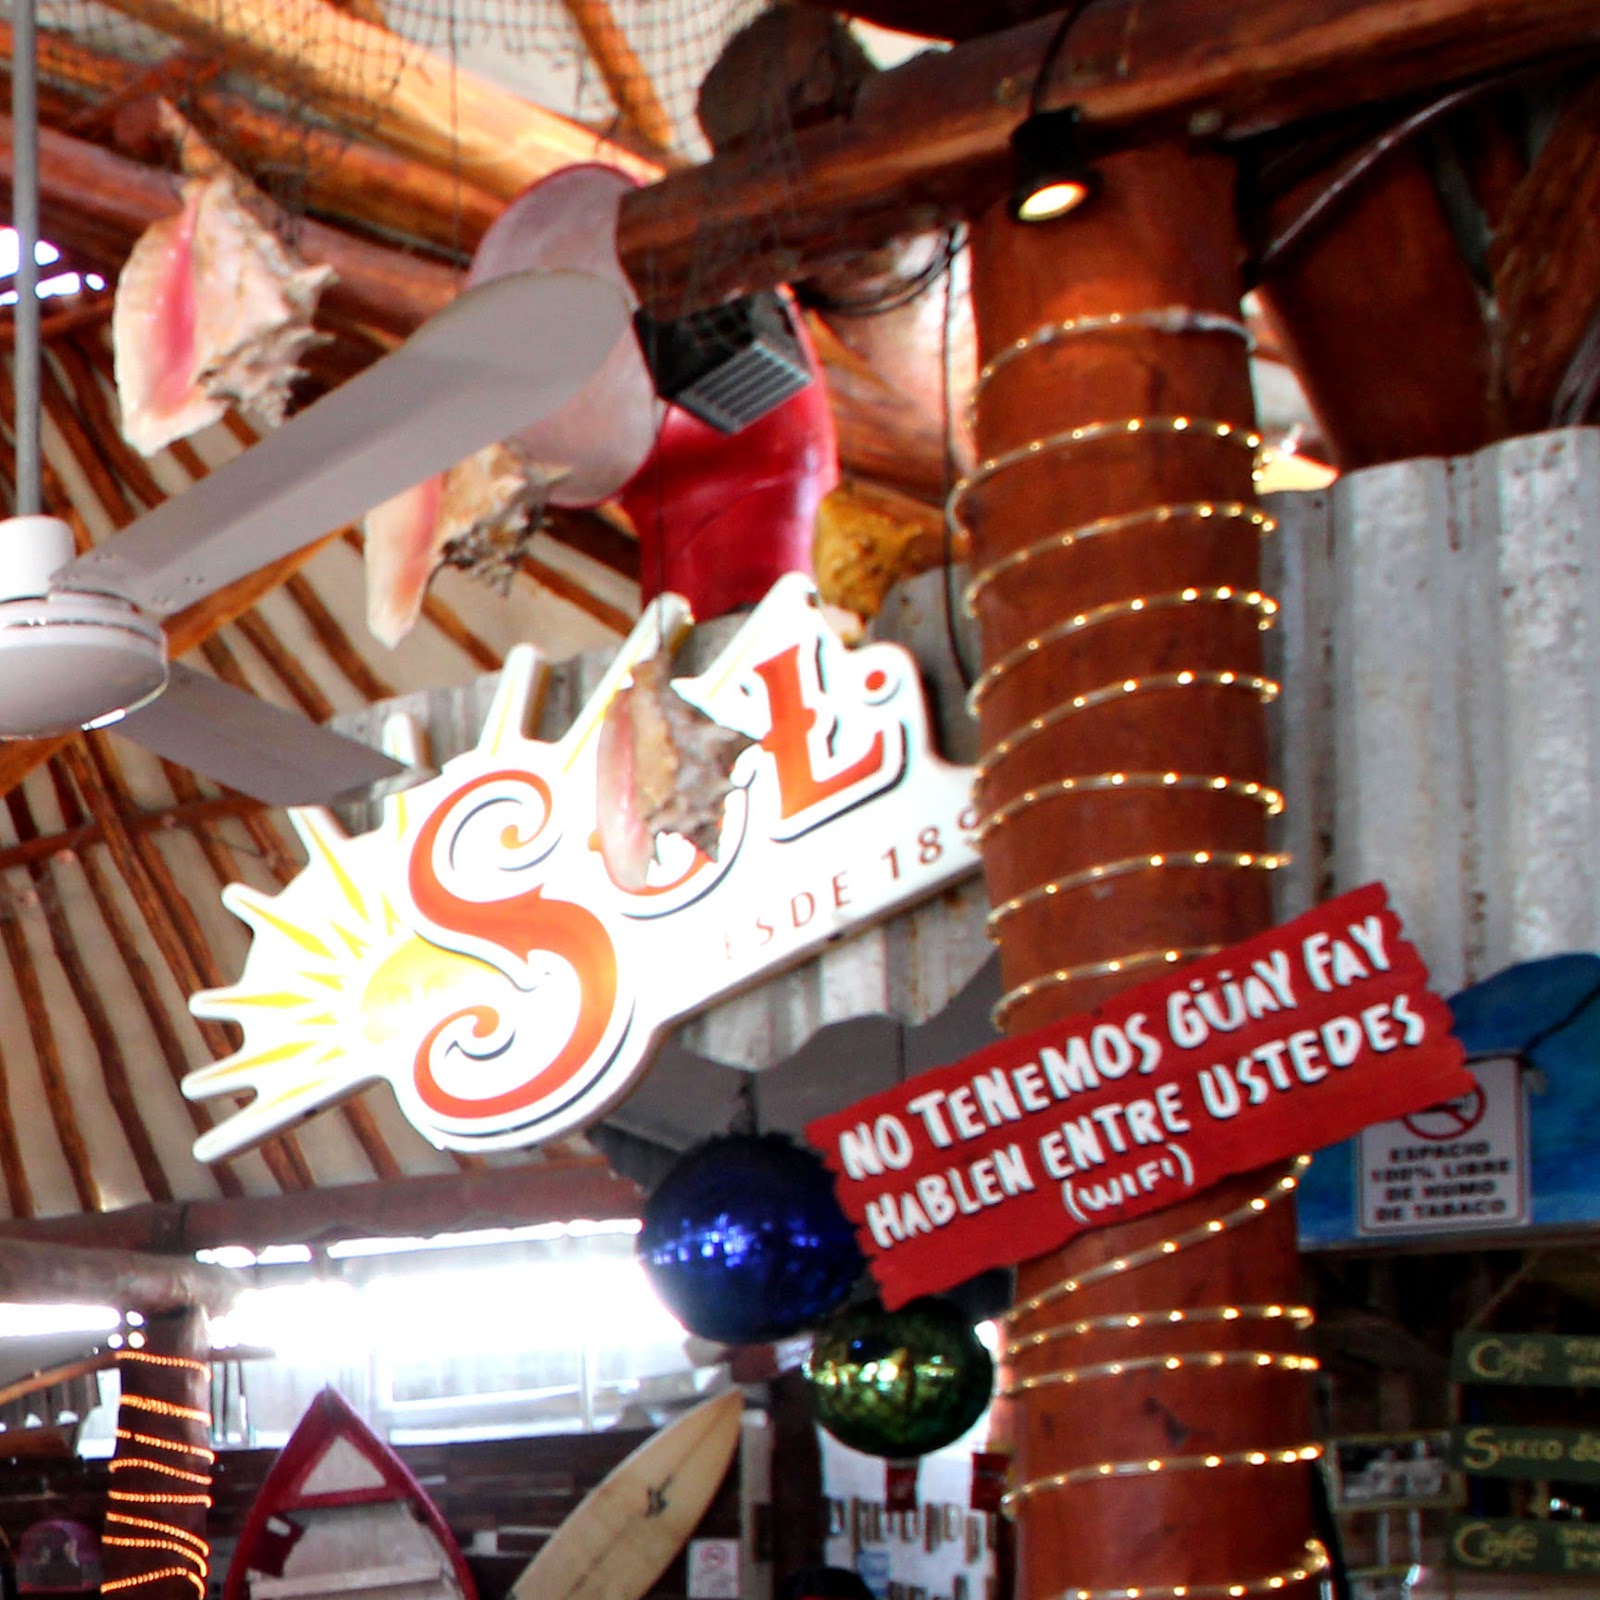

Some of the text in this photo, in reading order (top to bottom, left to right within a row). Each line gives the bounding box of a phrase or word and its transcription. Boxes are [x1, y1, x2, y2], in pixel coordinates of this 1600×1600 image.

[839, 915, 1390, 1181] NO TENEMOS GÜAY FAY
[865, 994, 1425, 1249] HABLEN ENTRE USTEDES
[1388, 1141, 1490, 1163] ESPACIO
[1442, 1159, 1510, 1179] LIBRE
[1385, 1180, 1496, 1203] DE HUMO
[1375, 1199, 1505, 1222] DE TABACO
